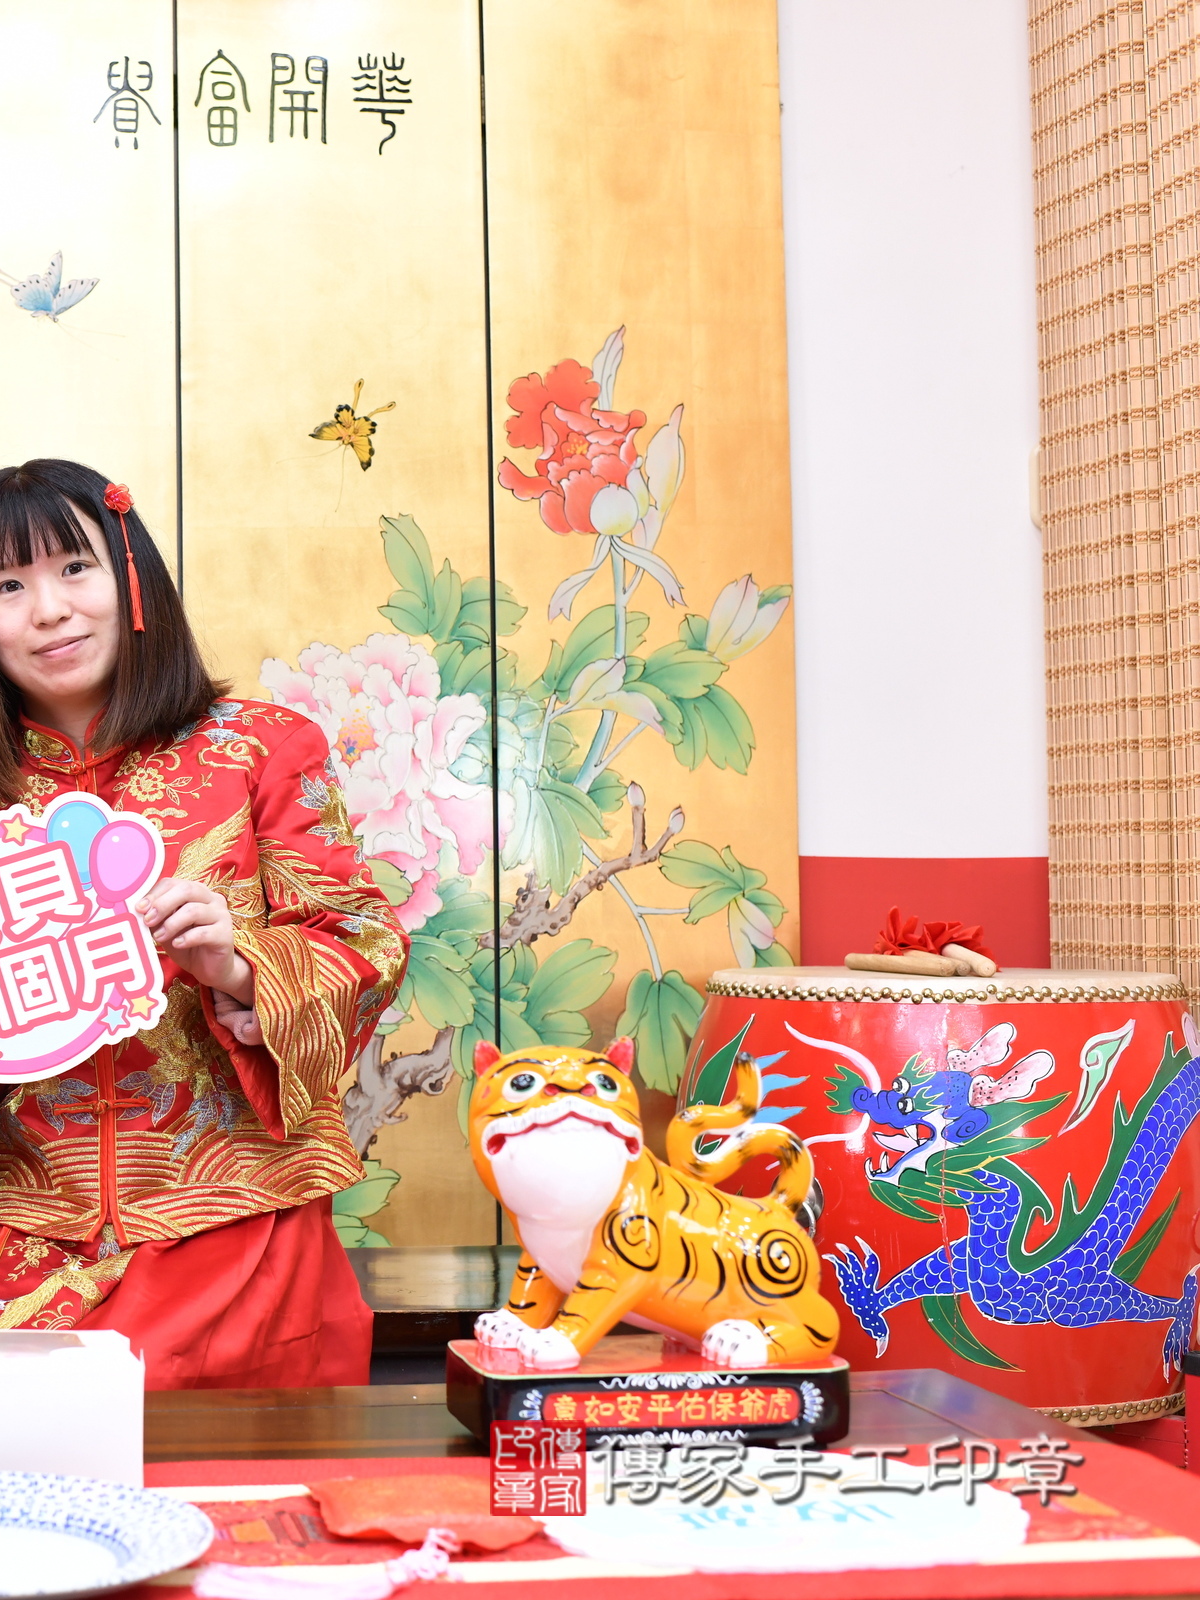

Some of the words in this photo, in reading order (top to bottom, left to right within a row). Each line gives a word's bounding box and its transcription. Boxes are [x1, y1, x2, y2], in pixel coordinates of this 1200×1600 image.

[553, 1386, 793, 1426] 虎爺保佑平安如意
